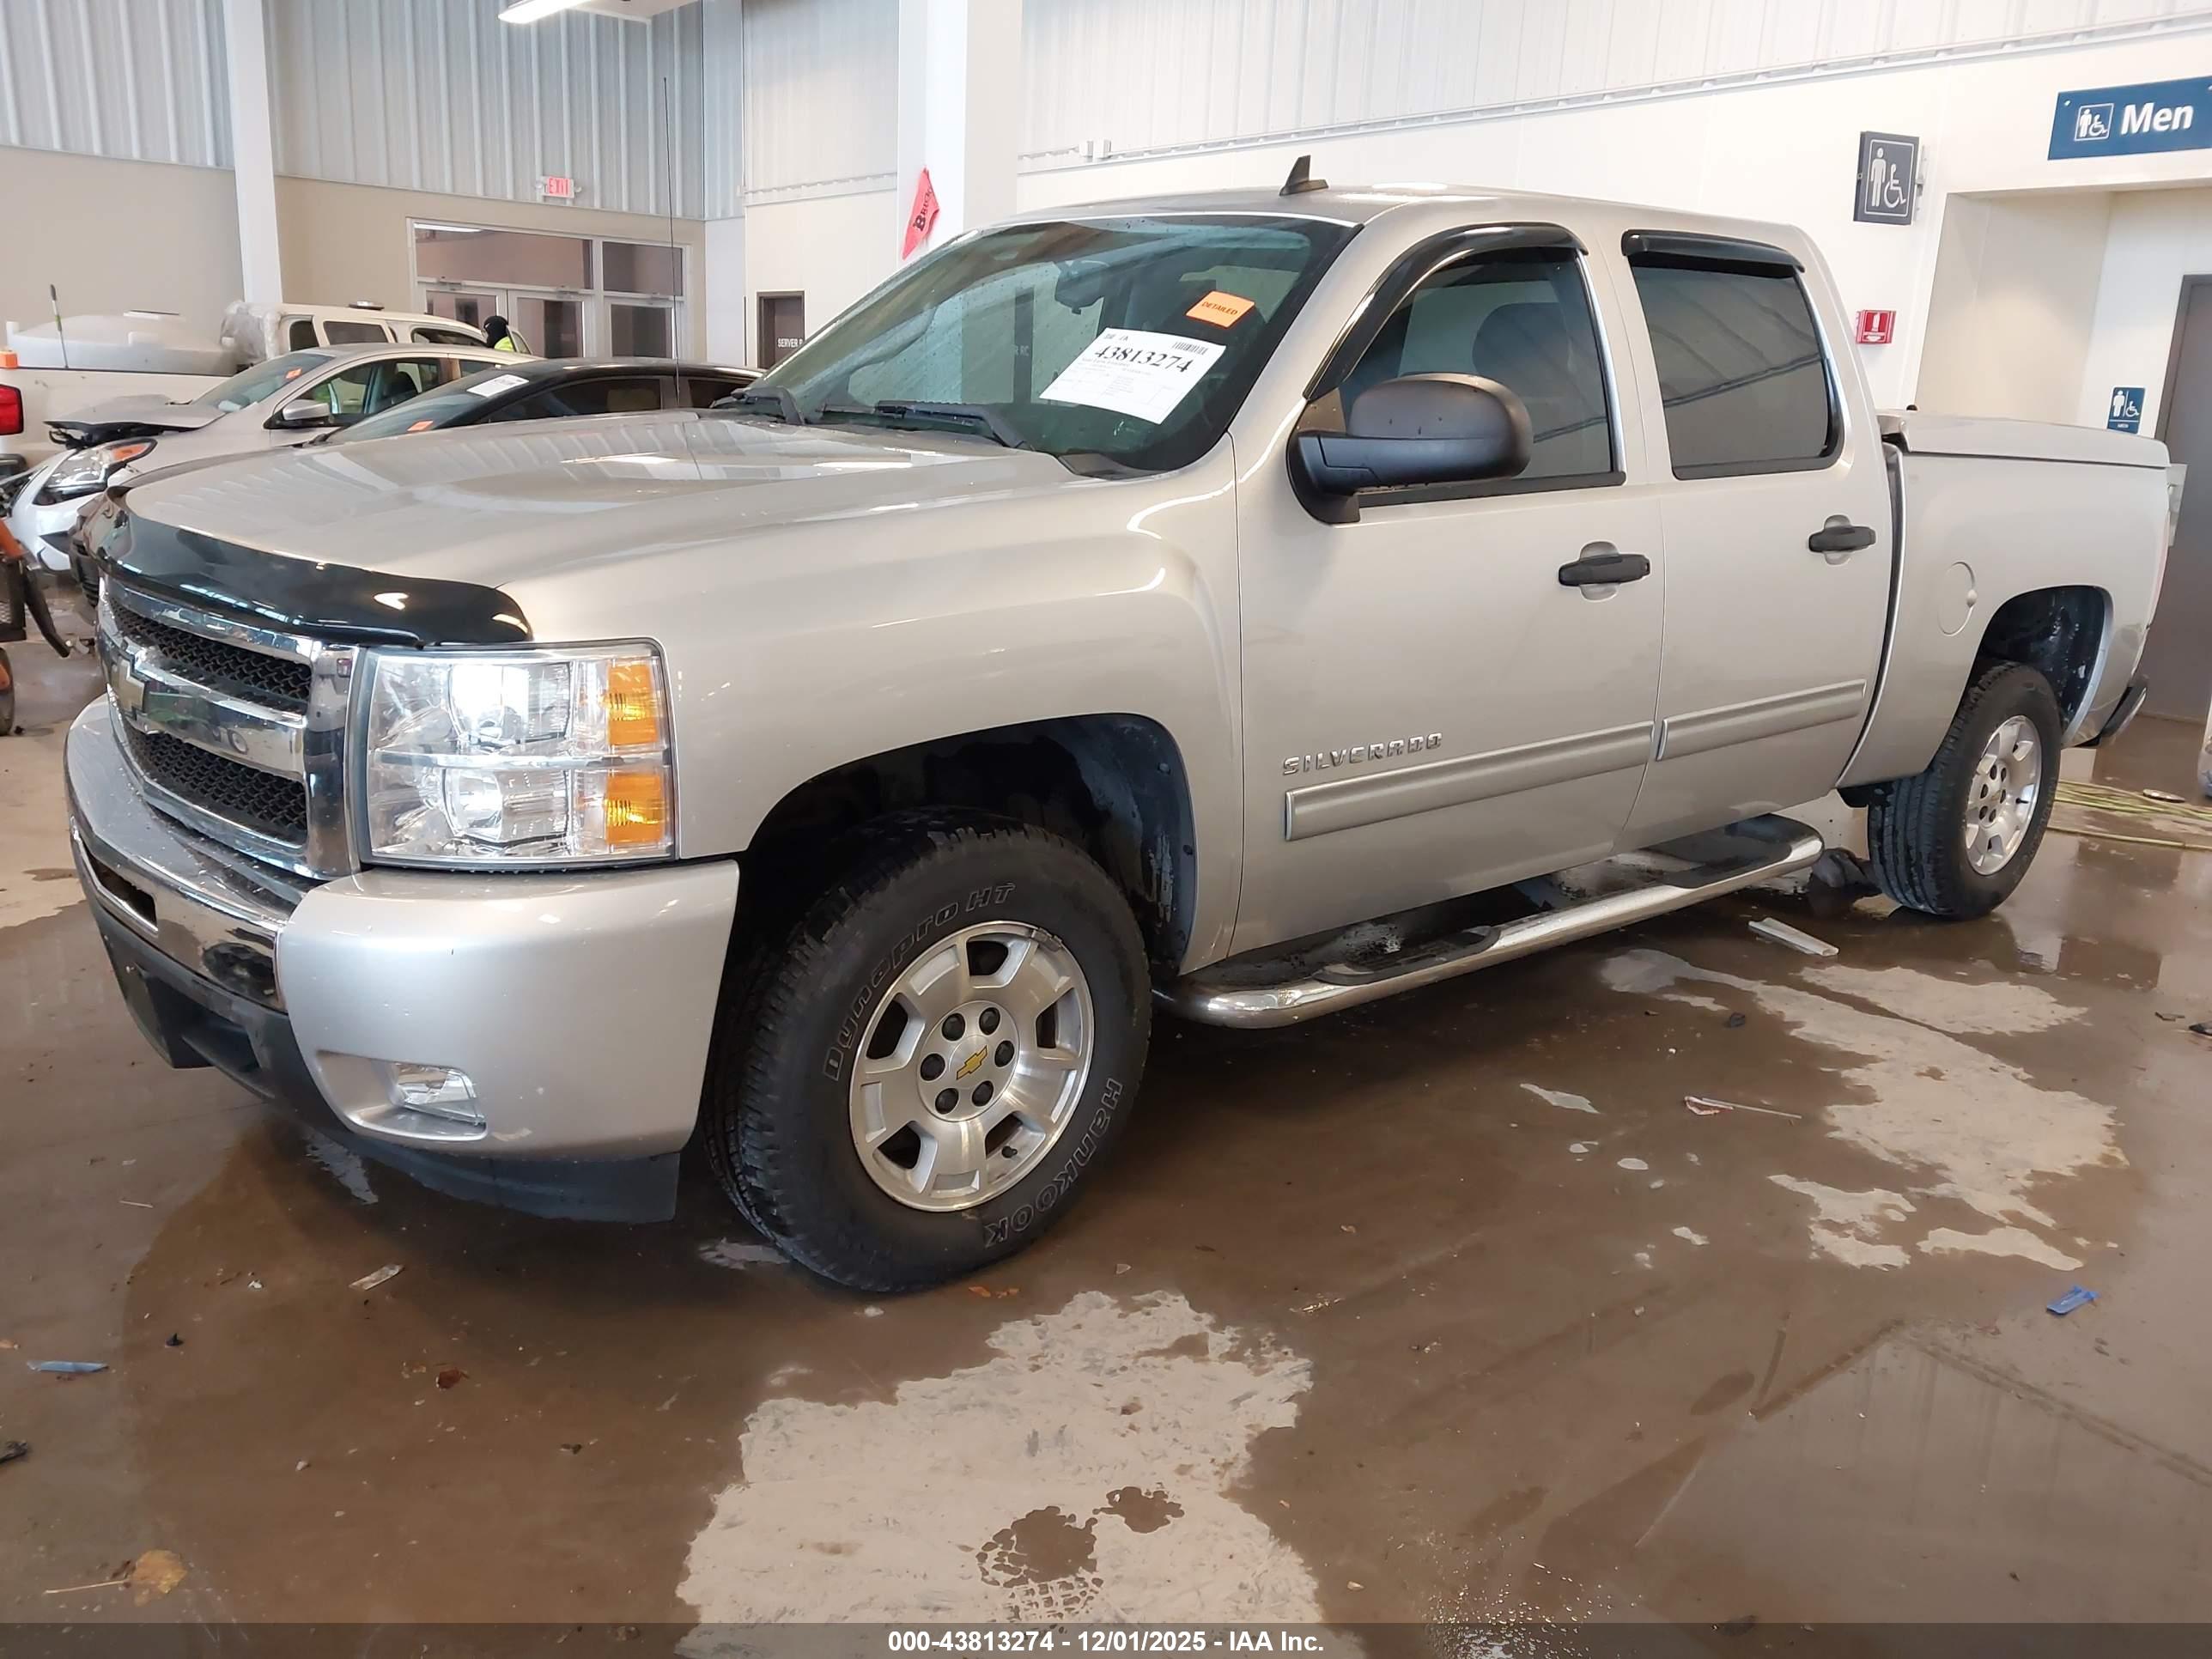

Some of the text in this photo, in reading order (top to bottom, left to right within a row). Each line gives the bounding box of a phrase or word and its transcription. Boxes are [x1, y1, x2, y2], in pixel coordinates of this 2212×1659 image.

[2121, 102, 2194, 135] Men
[1202, 301, 1238, 315] DETAILED
[777, 337, 799, 348] SERVER
[1094, 345, 1194, 373] 43813274
[1283, 732, 1443, 775] SILVERADO
[966, 883, 1017, 912] HT
